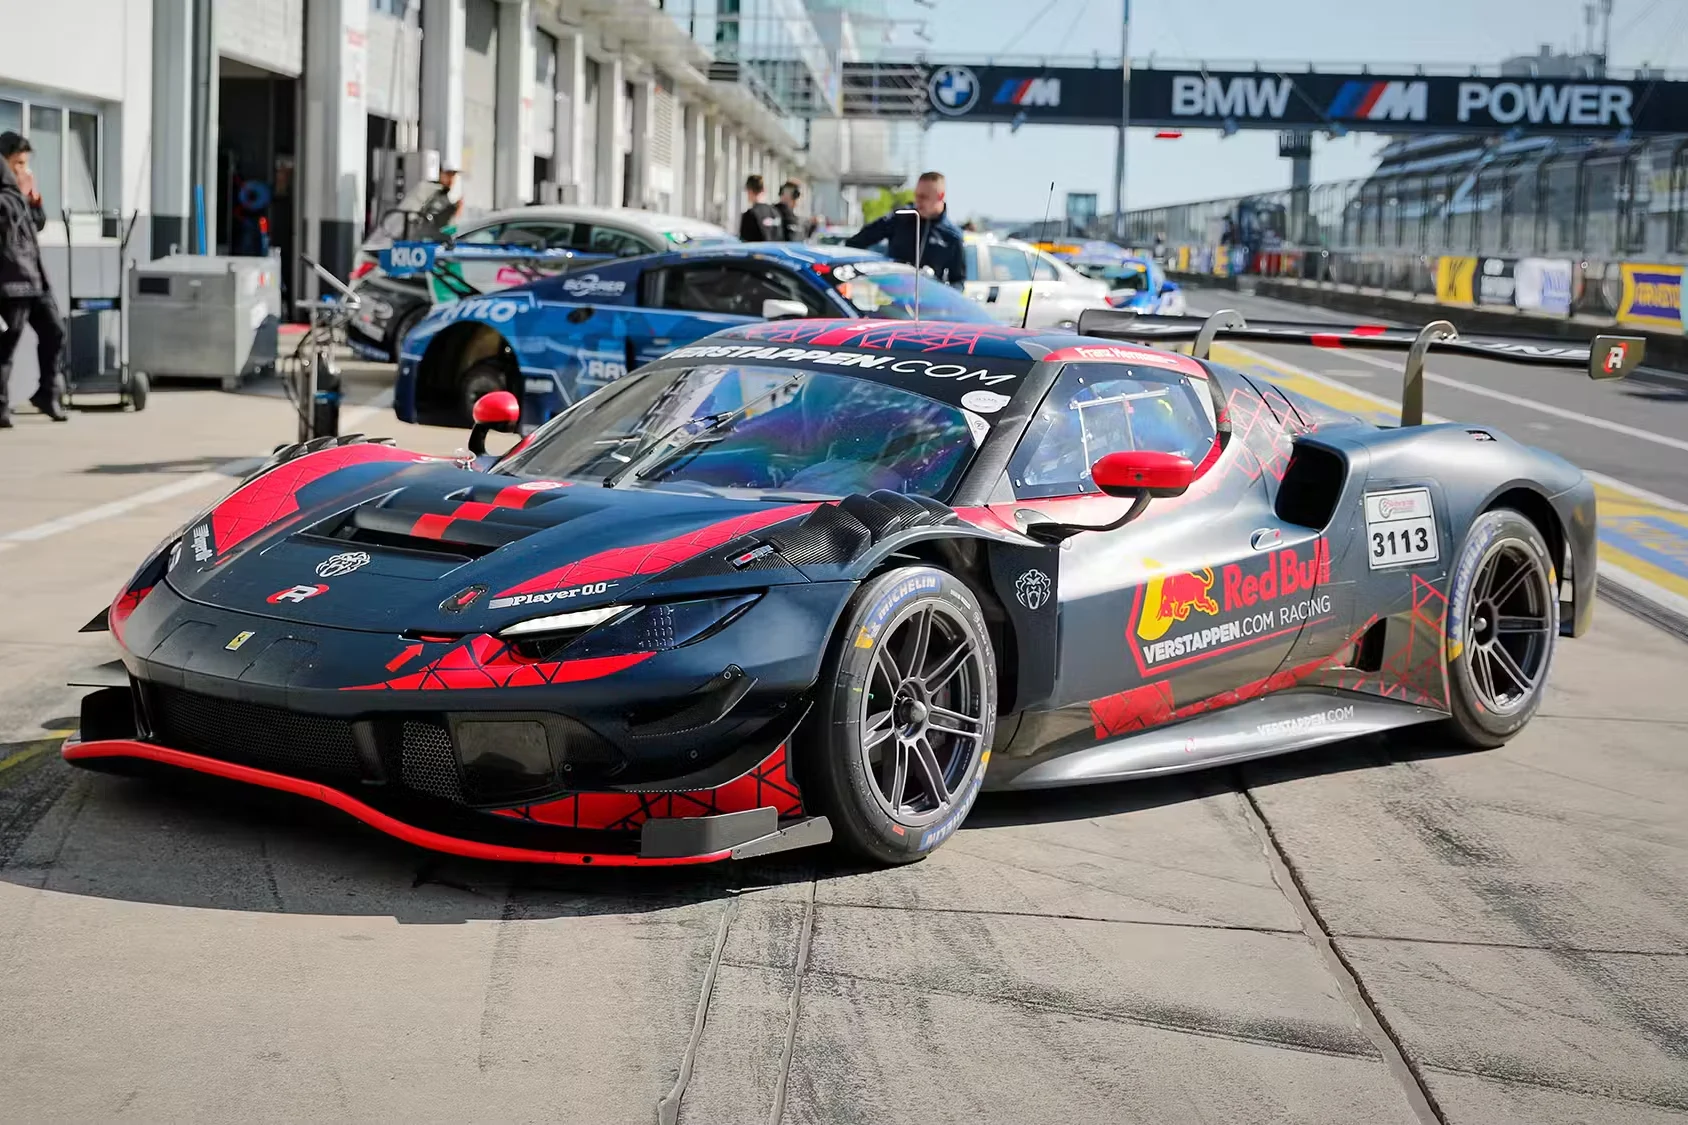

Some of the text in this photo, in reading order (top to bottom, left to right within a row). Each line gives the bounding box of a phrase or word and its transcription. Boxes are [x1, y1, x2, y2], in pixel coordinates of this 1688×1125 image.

[1171, 77, 1292, 117] BMW
[1457, 83, 1633, 125] POWER
[1373, 527, 1429, 557] 3113
[511, 583, 607, 606] Player 0.0
[1223, 537, 1330, 611] Red Bull
[878, 576, 937, 621] MICHELIN
[1143, 595, 1331, 664] VERSTAPPEN.COM RACING
[1257, 705, 1354, 737] VERSTAPPEN.COM
